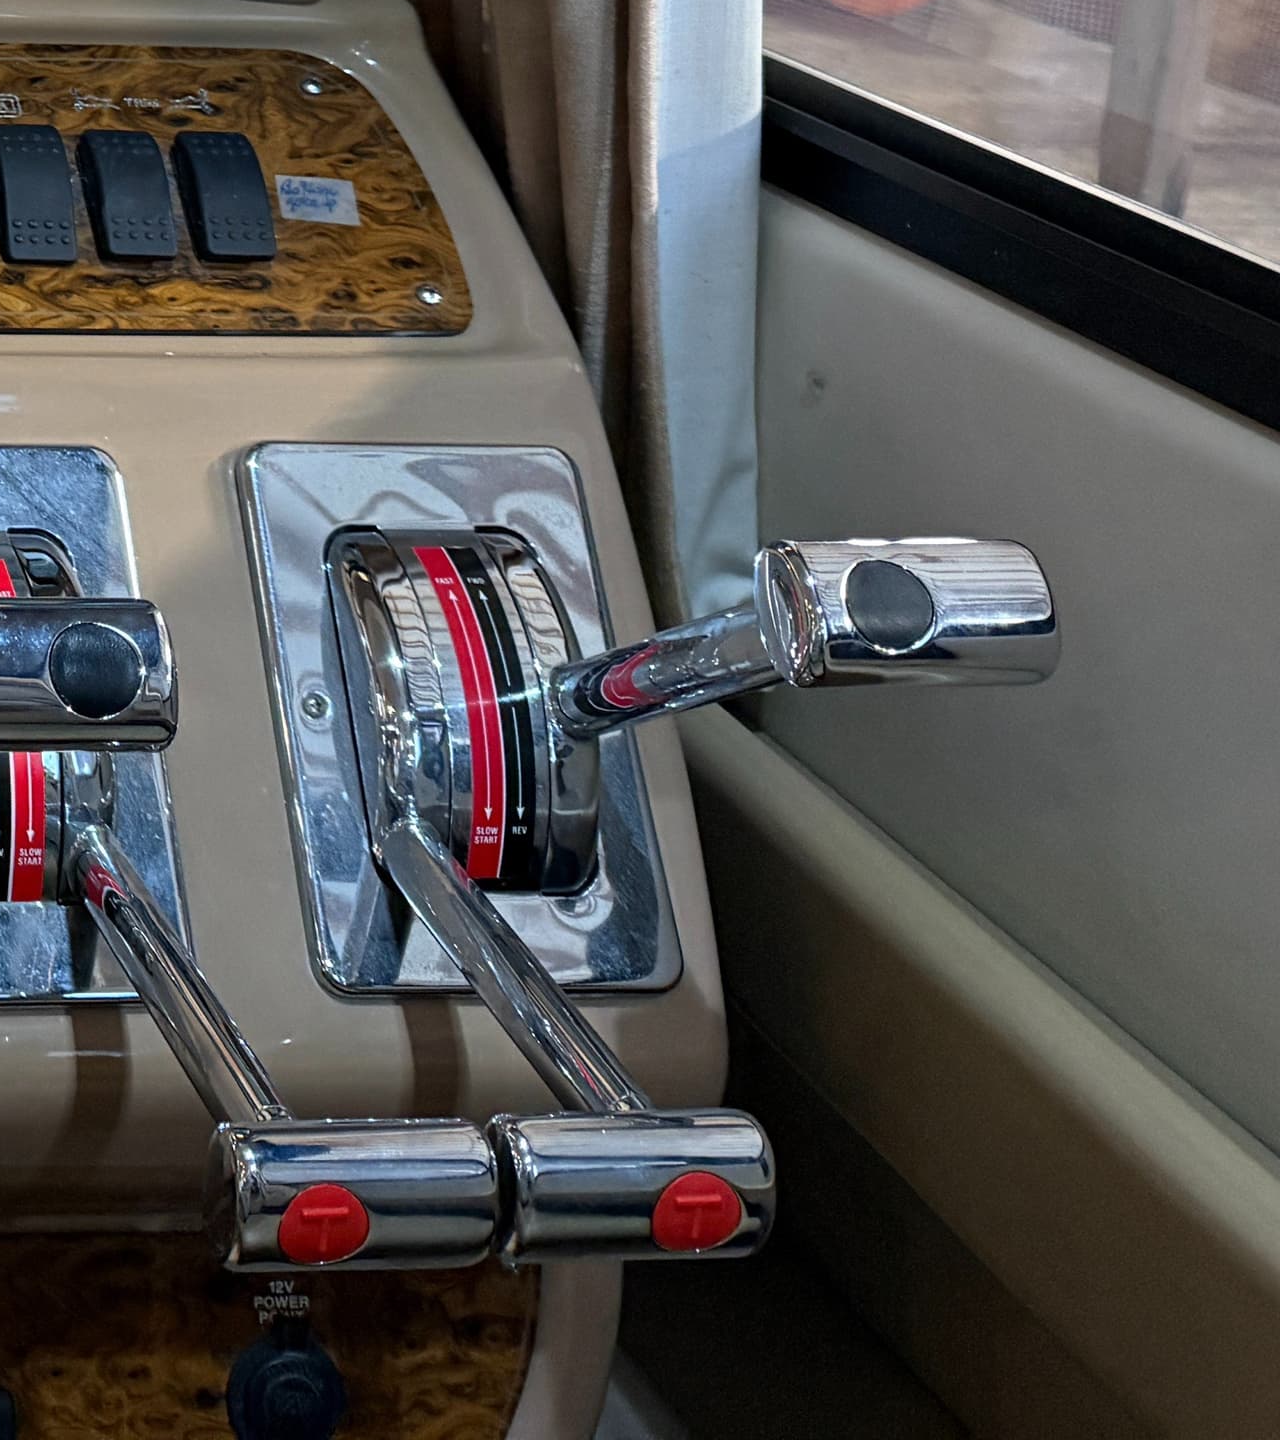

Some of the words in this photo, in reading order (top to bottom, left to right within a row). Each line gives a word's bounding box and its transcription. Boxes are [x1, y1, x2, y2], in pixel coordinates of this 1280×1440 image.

[434, 577, 455, 585] FAST
[475, 825, 499, 835] SLOW
[512, 825, 528, 835] REV
[473, 835, 498, 845] START
[19, 847, 42, 857] SLOW
[17, 857, 42, 866] START
[269, 1280, 295, 1294] 12V
[254, 1295, 310, 1310] POWER
